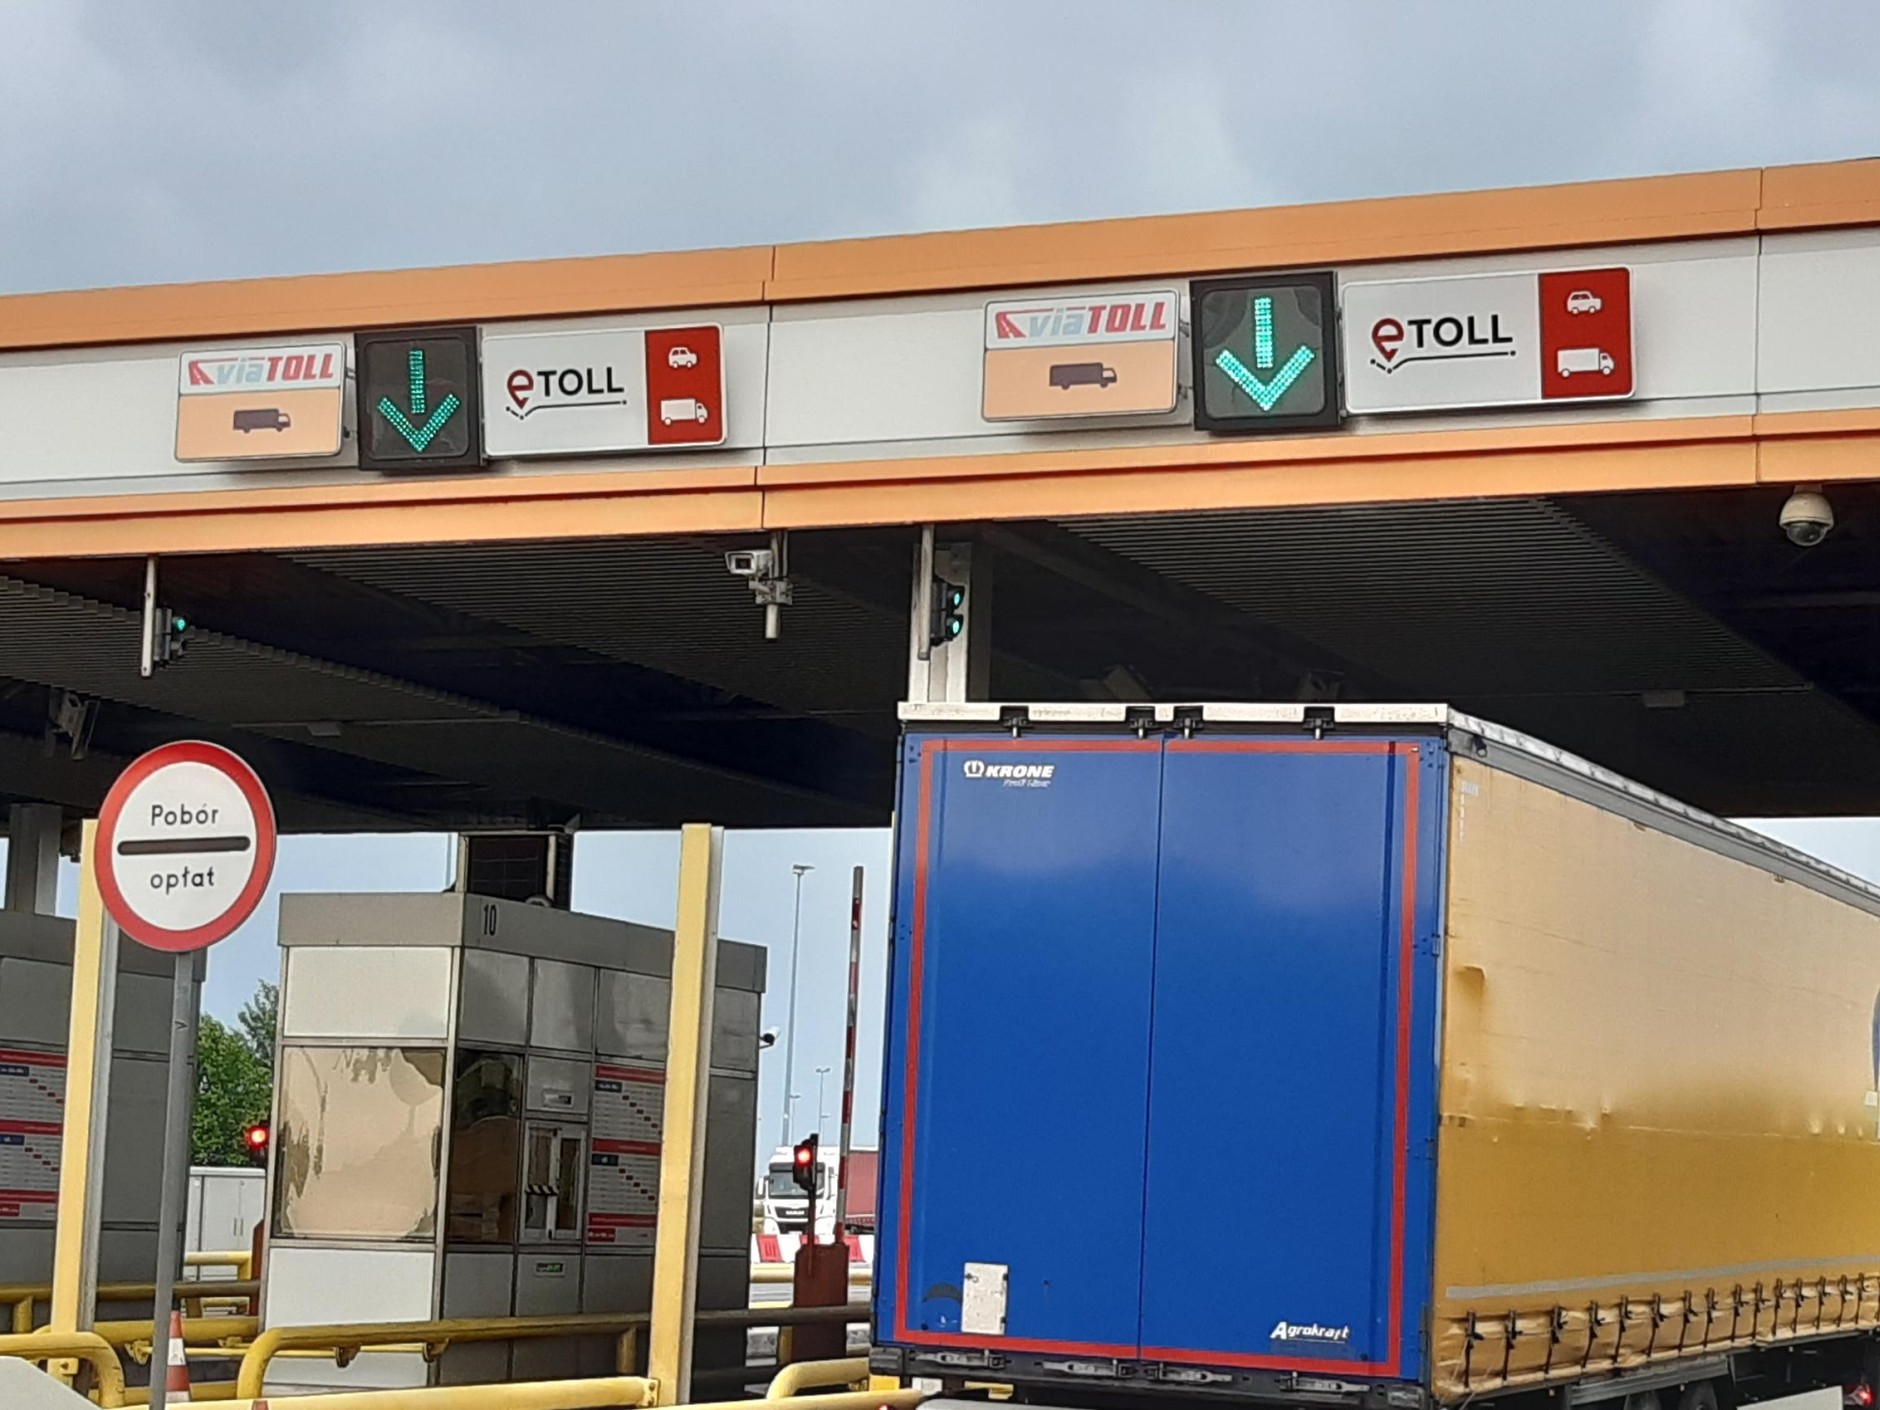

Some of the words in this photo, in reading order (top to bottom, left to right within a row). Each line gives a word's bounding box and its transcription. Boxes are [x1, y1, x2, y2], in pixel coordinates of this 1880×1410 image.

[1024, 301, 1167, 337] viaTOLL
[1371, 314, 1513, 360] eTOLL
[216, 353, 334, 384] viaTOLL
[507, 367, 625, 408] eTOLL
[986, 765, 1055, 778] KRONE
[151, 803, 219, 826] Pobór
[150, 866, 215, 895] opłat
[483, 903, 497, 936] 10
[1270, 1321, 1350, 1341] Agrokraft
